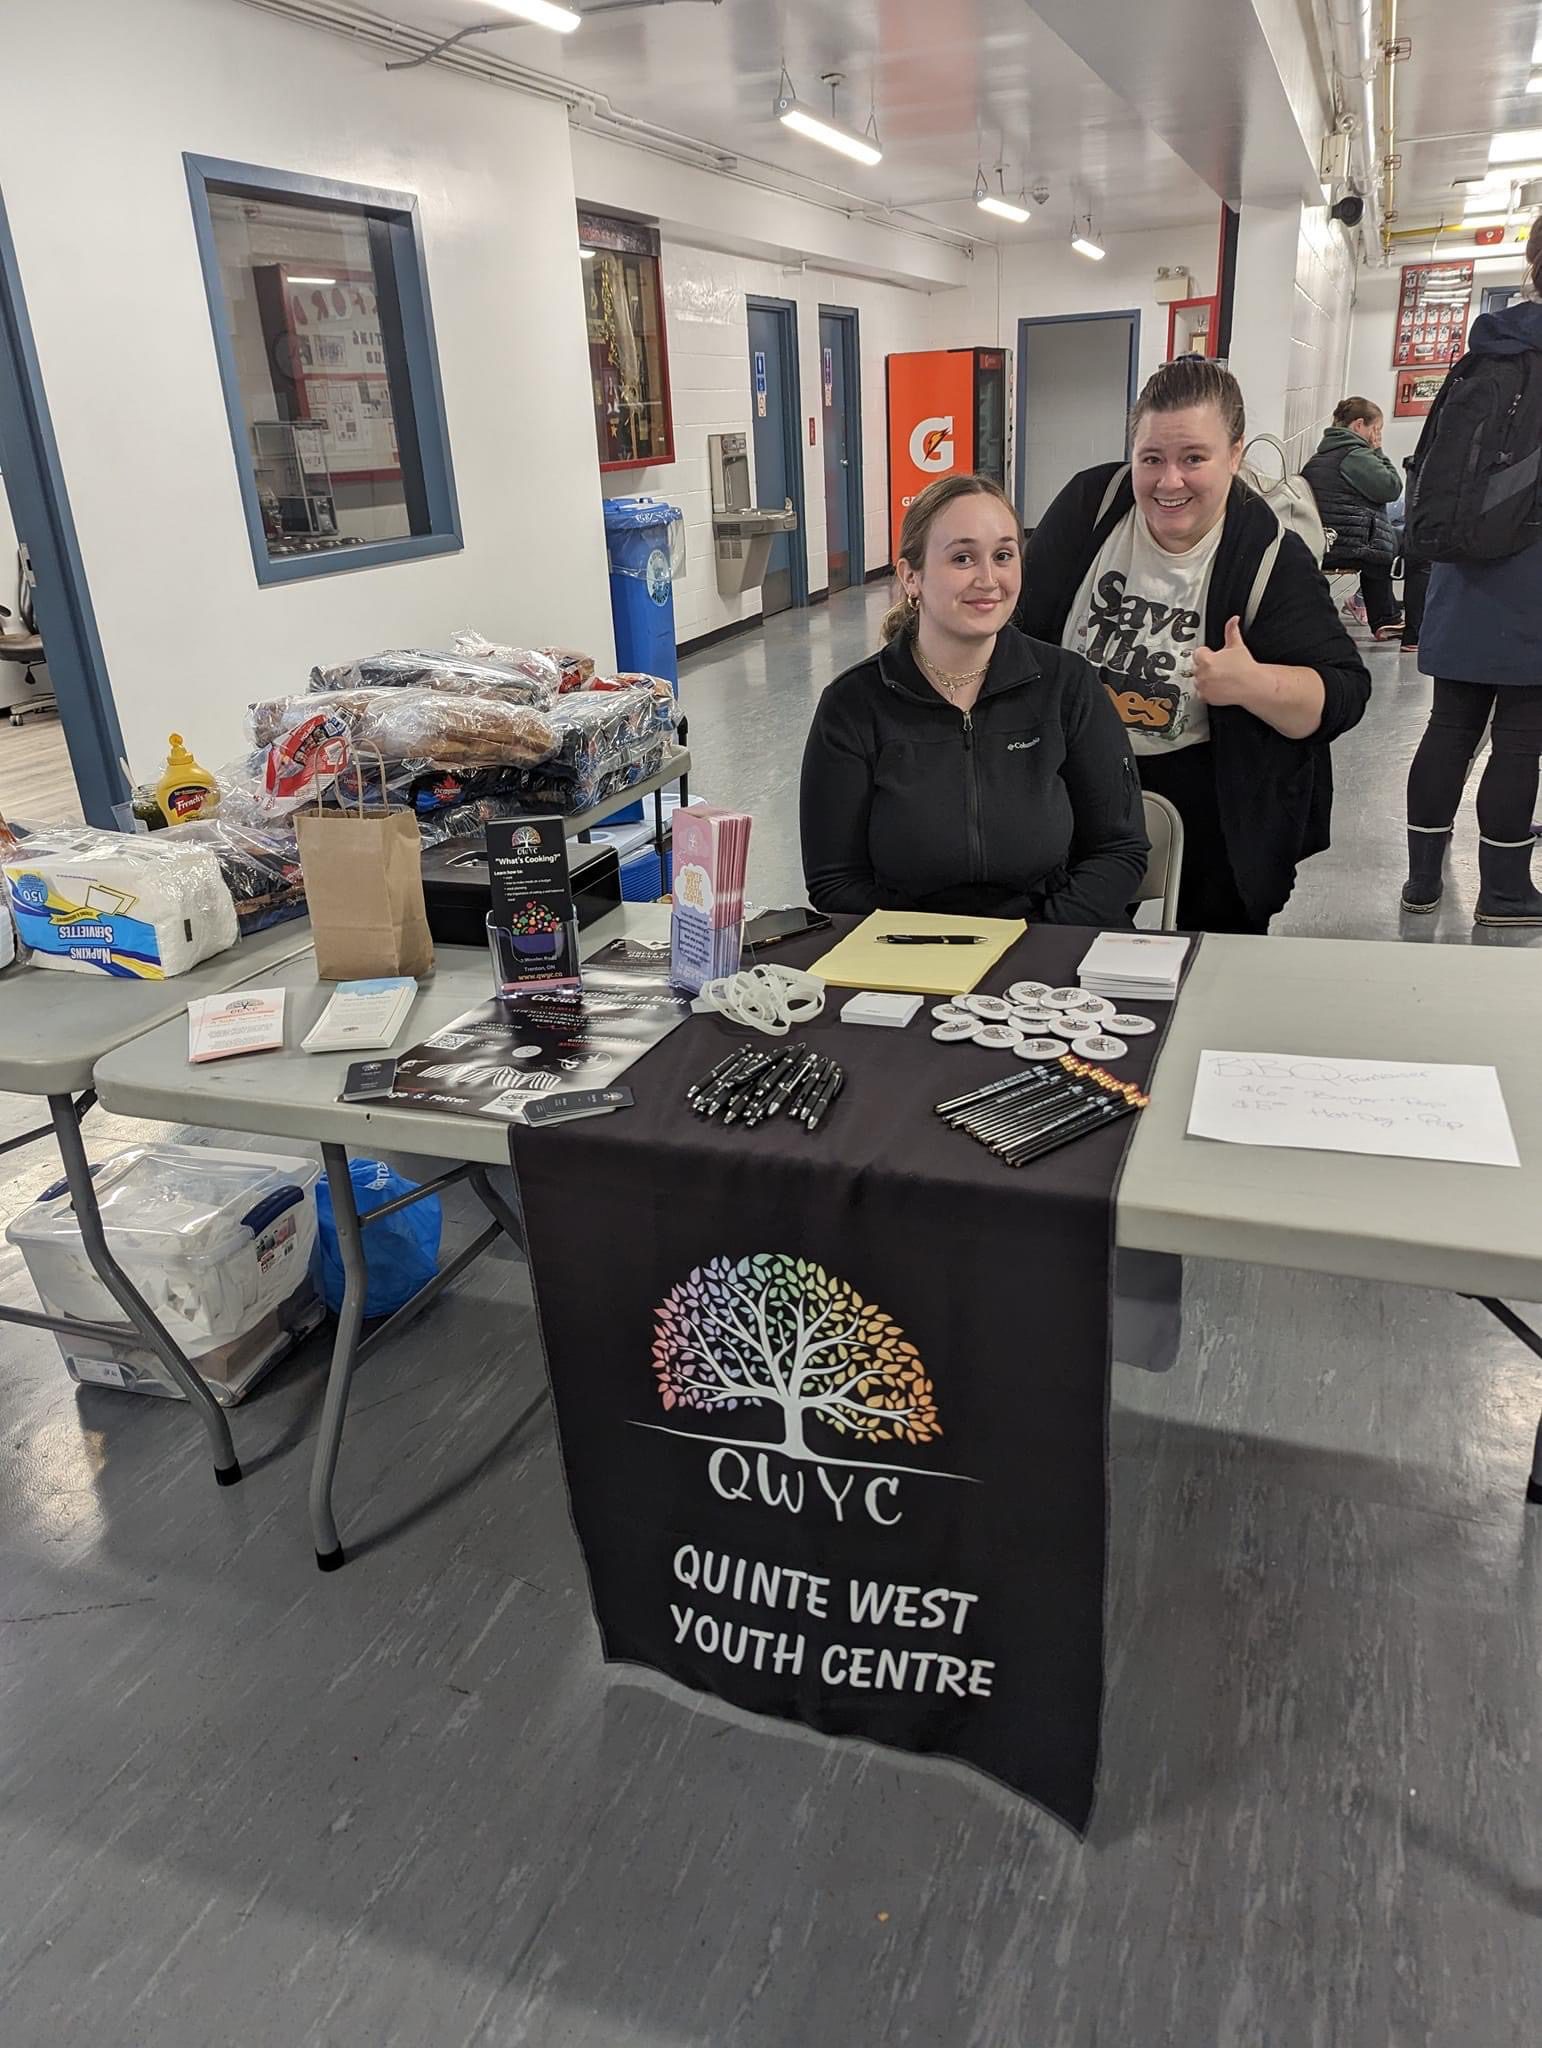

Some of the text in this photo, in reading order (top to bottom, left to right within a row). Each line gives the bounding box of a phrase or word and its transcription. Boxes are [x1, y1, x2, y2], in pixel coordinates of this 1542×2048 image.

[909, 415, 955, 473] G
[1089, 570, 1200, 643] Save
[1087, 612, 1176, 682] The
[1014, 736, 1040, 749] Columbia
[176, 794, 205, 811] French's
[495, 853, 561, 865] "What's Cooking?"
[22, 890, 43, 902] 150
[531, 994, 577, 1004] Circus
[1208, 1056, 1343, 1086] BBQ
[708, 1447, 903, 1525] QWYC
[673, 1544, 979, 1635] QUINTE WEST
[670, 1603, 996, 1698] YOUTH CENTRE
